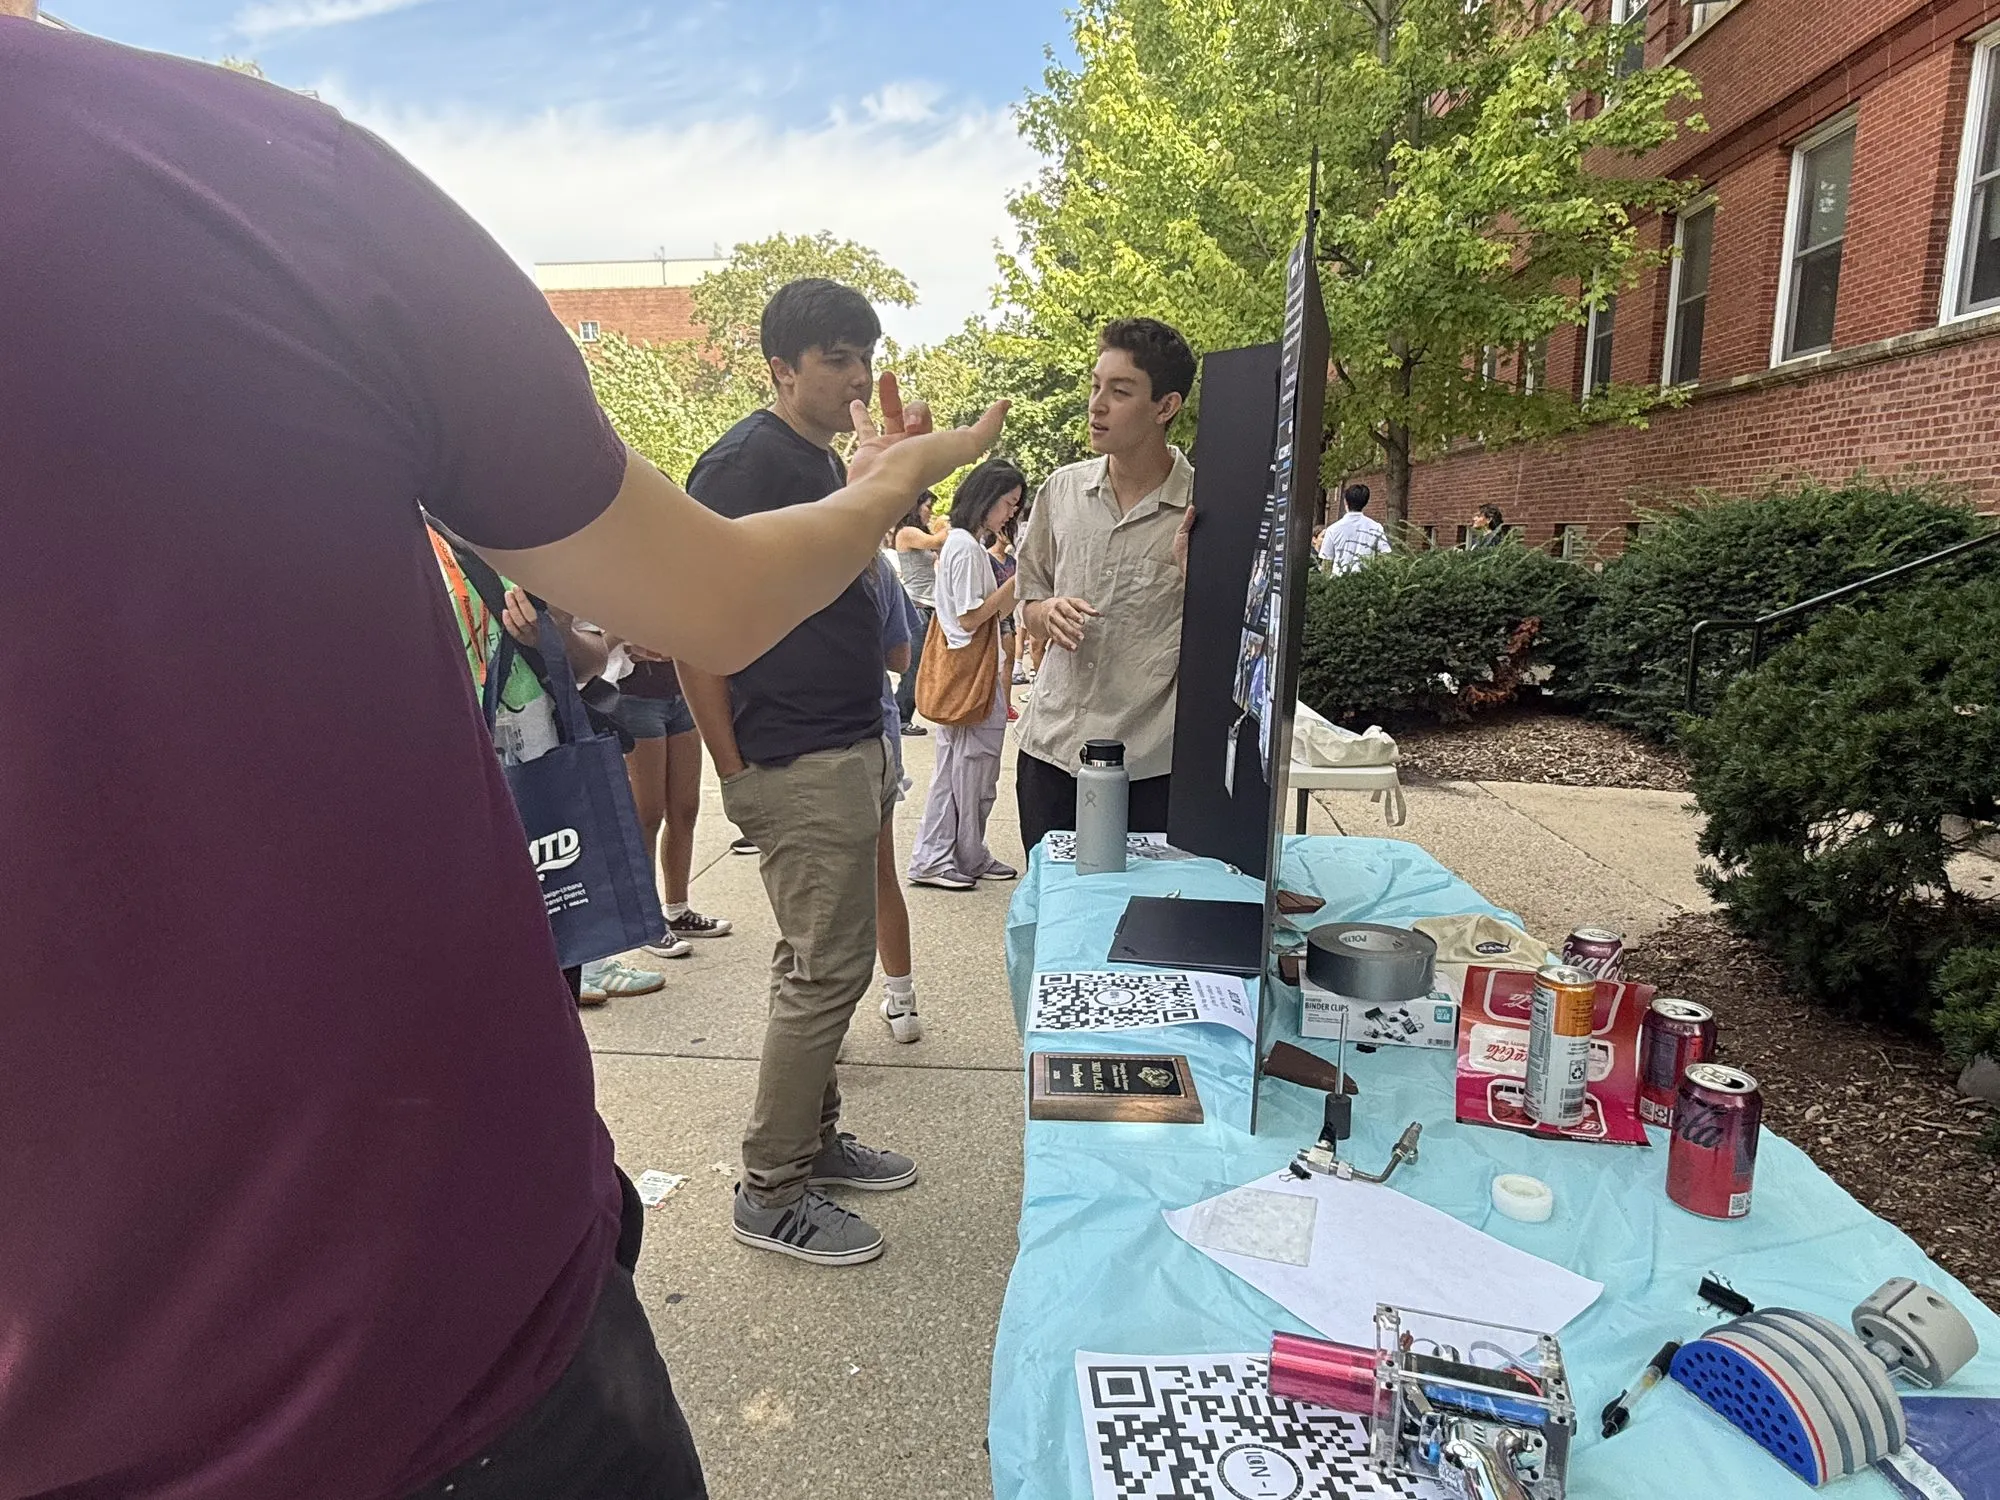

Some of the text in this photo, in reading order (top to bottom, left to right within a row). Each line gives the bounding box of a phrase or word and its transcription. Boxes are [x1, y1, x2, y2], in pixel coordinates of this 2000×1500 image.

[1305, 1002, 1349, 1013] BINDER CLIPS
[1482, 1043, 1528, 1063] ca-Cola
[1092, 1072, 1104, 1092] PLACE
